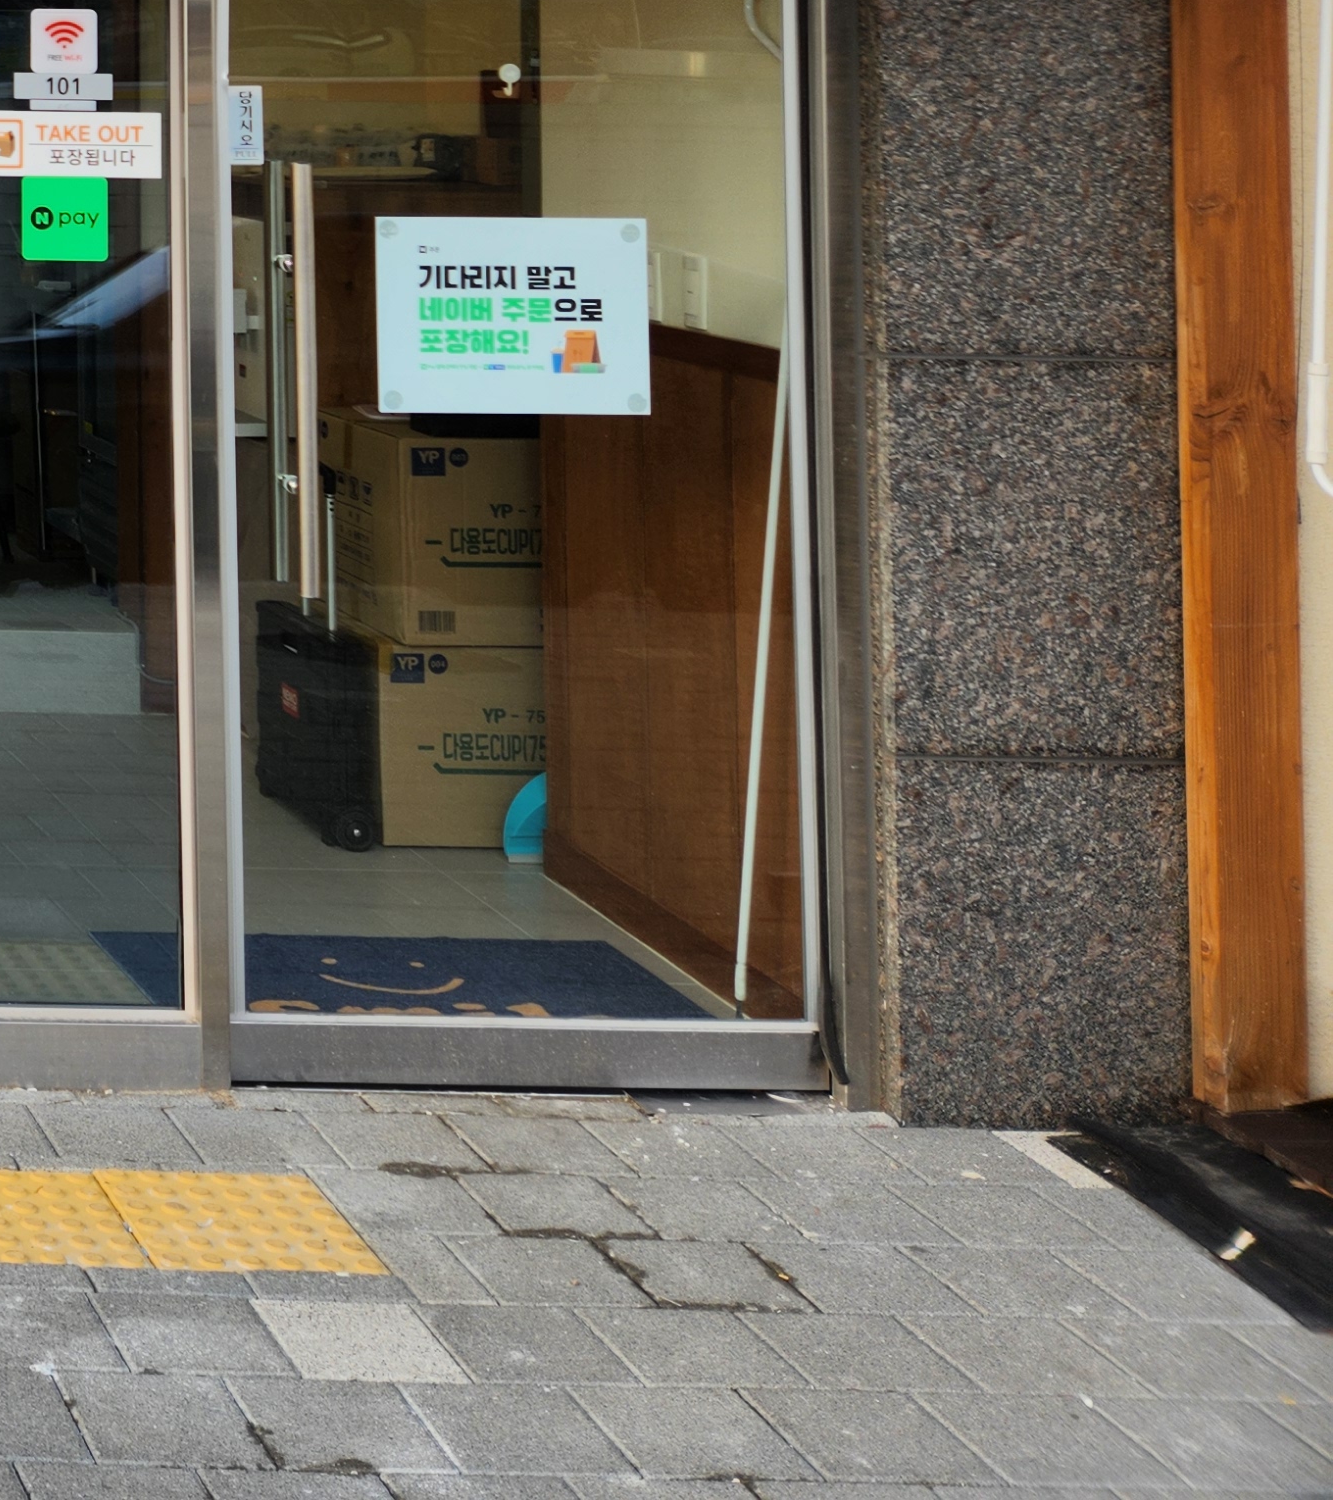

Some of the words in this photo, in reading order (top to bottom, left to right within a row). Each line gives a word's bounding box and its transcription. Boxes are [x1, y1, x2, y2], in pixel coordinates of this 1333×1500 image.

[46, 77, 80, 95] 101
[239, 91, 254, 146] 당기시오
[36, 125, 91, 142] TAKE
[99, 125, 144, 143] OUT
[49, 148, 136, 167] 포장됩니다
[58, 209, 100, 228] pay
[418, 265, 516, 290] 기다리지
[527, 266, 576, 290] 말고
[419, 297, 493, 322] 네이버
[501, 297, 603, 322] 주문으로
[419, 329, 529, 355] 포장해요!
[418, 451, 439, 464] YP
[490, 504, 513, 518] YP
[451, 528, 542, 555] 다용도CUP(7
[397, 656, 420, 670] YP
[483, 708, 506, 723] YP
